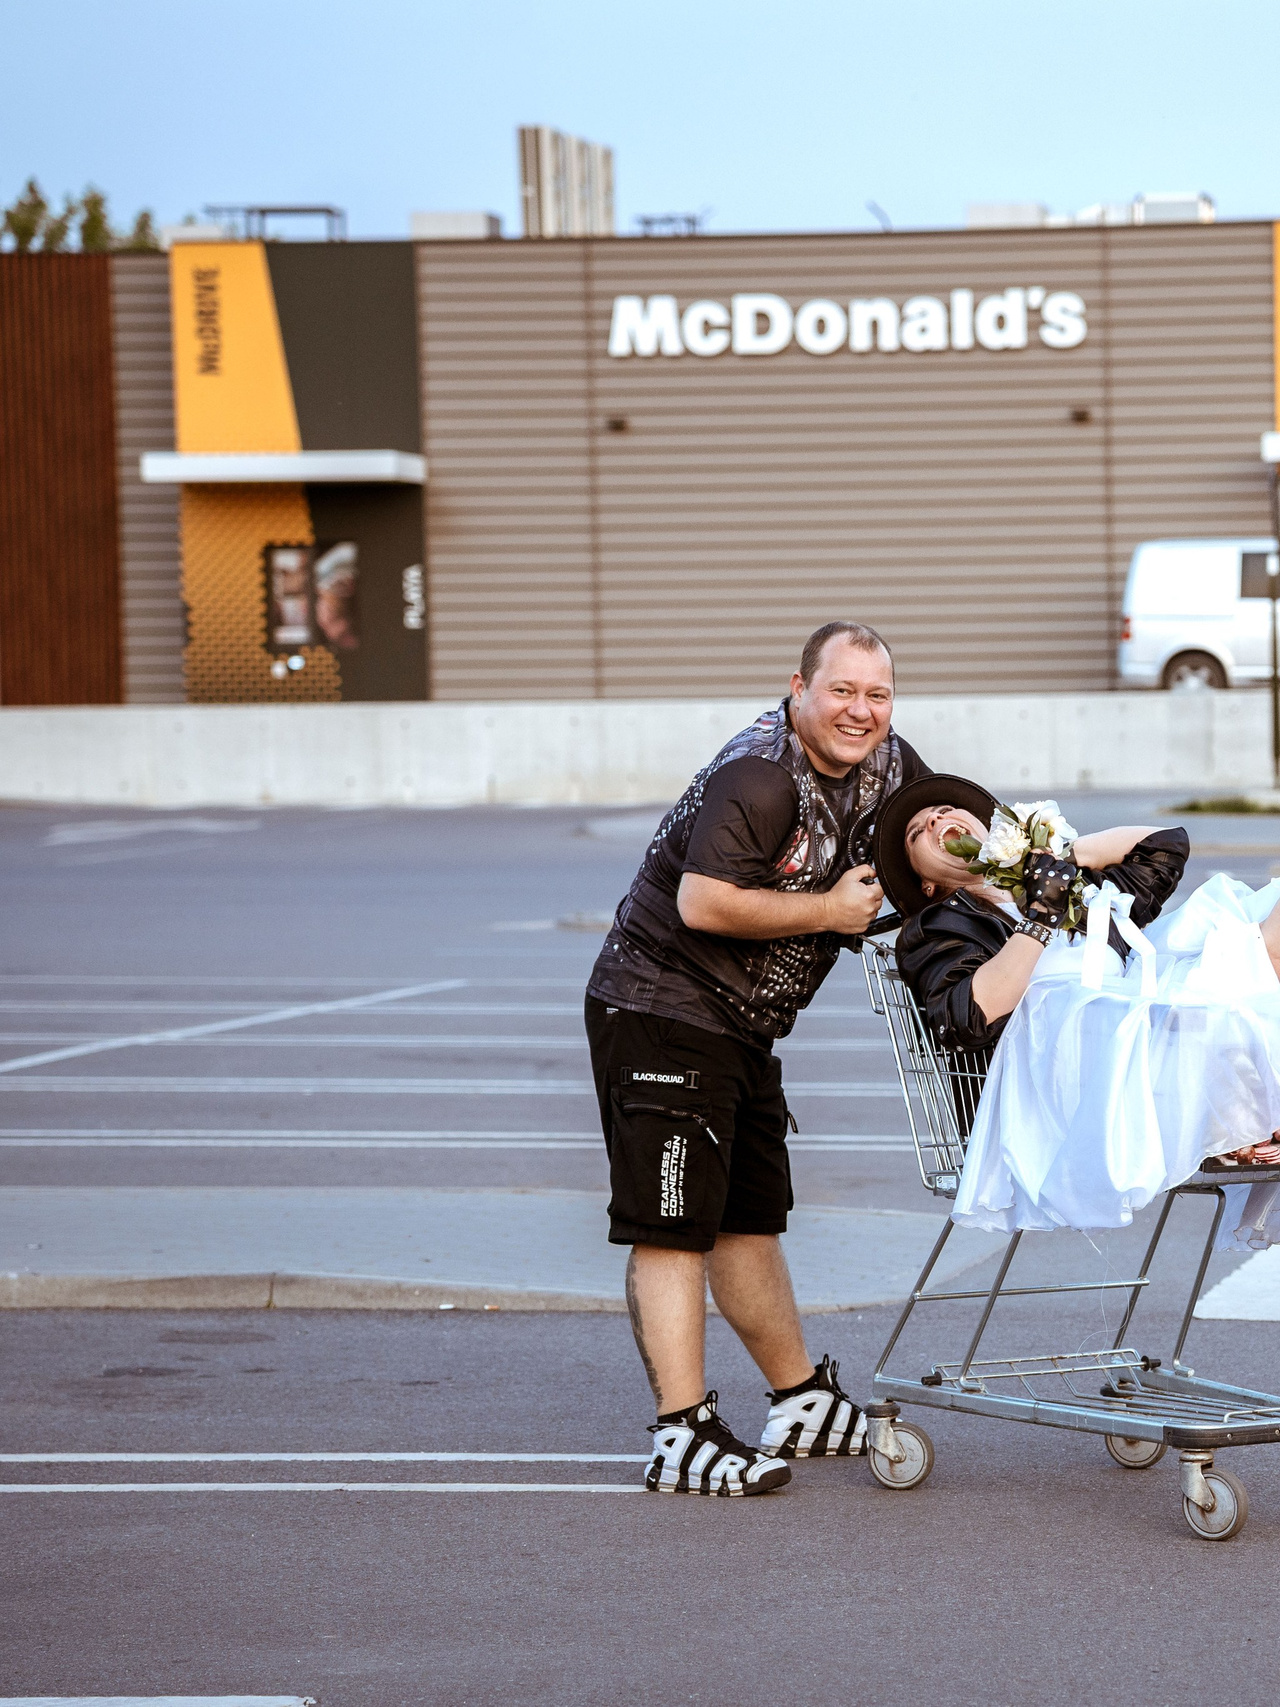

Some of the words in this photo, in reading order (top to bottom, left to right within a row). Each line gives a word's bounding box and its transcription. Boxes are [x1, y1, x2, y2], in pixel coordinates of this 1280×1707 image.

[608, 287, 1087, 357] McDonald's
[632, 1072, 657, 1082] BLACK
[656, 1074, 685, 1084] SQUAD
[660, 1151, 671, 1217] FEARLESS
[669, 1135, 681, 1217] CONNECTION
[651, 1425, 748, 1486] AIR
